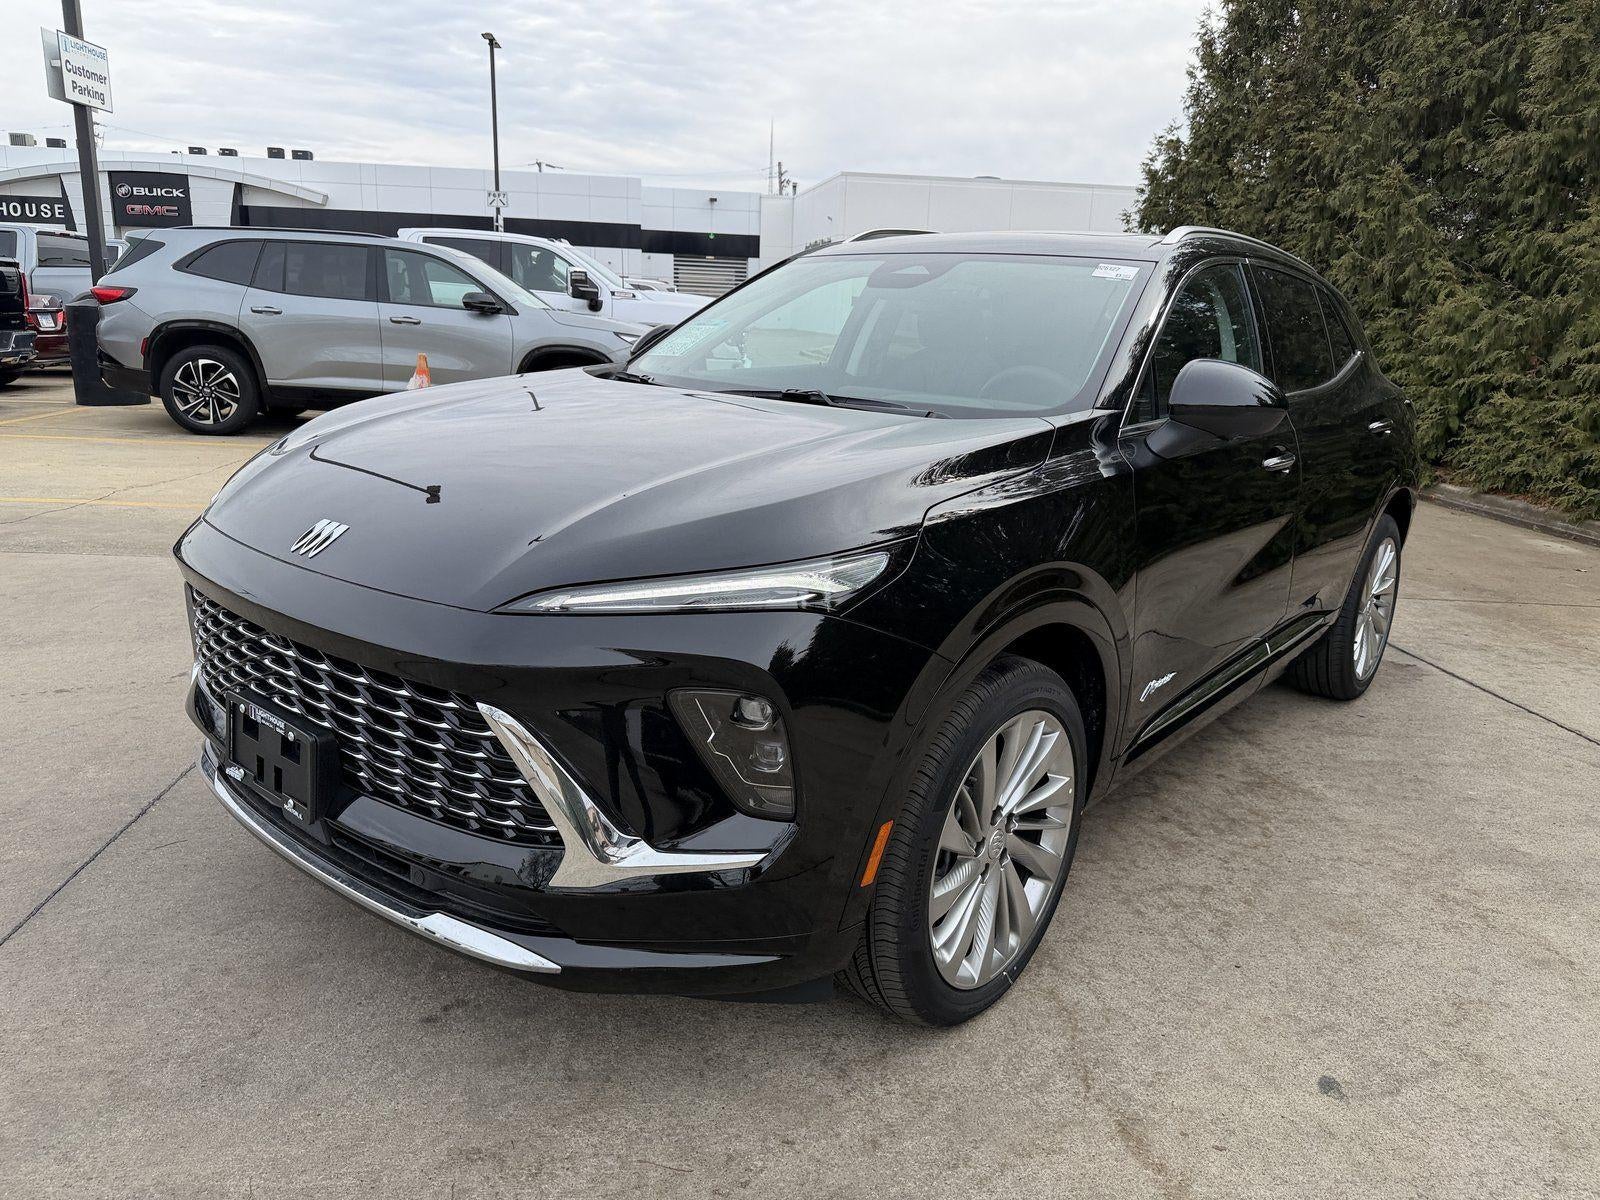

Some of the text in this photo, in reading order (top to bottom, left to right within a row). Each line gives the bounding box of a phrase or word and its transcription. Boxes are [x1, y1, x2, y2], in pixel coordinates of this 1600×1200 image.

[70, 39, 106, 60] LIGHTHOUSE
[65, 59, 107, 85] Customer
[71, 80, 105, 105] Parking
[133, 187, 185, 198] BUICK
[126, 204, 179, 217] GMC
